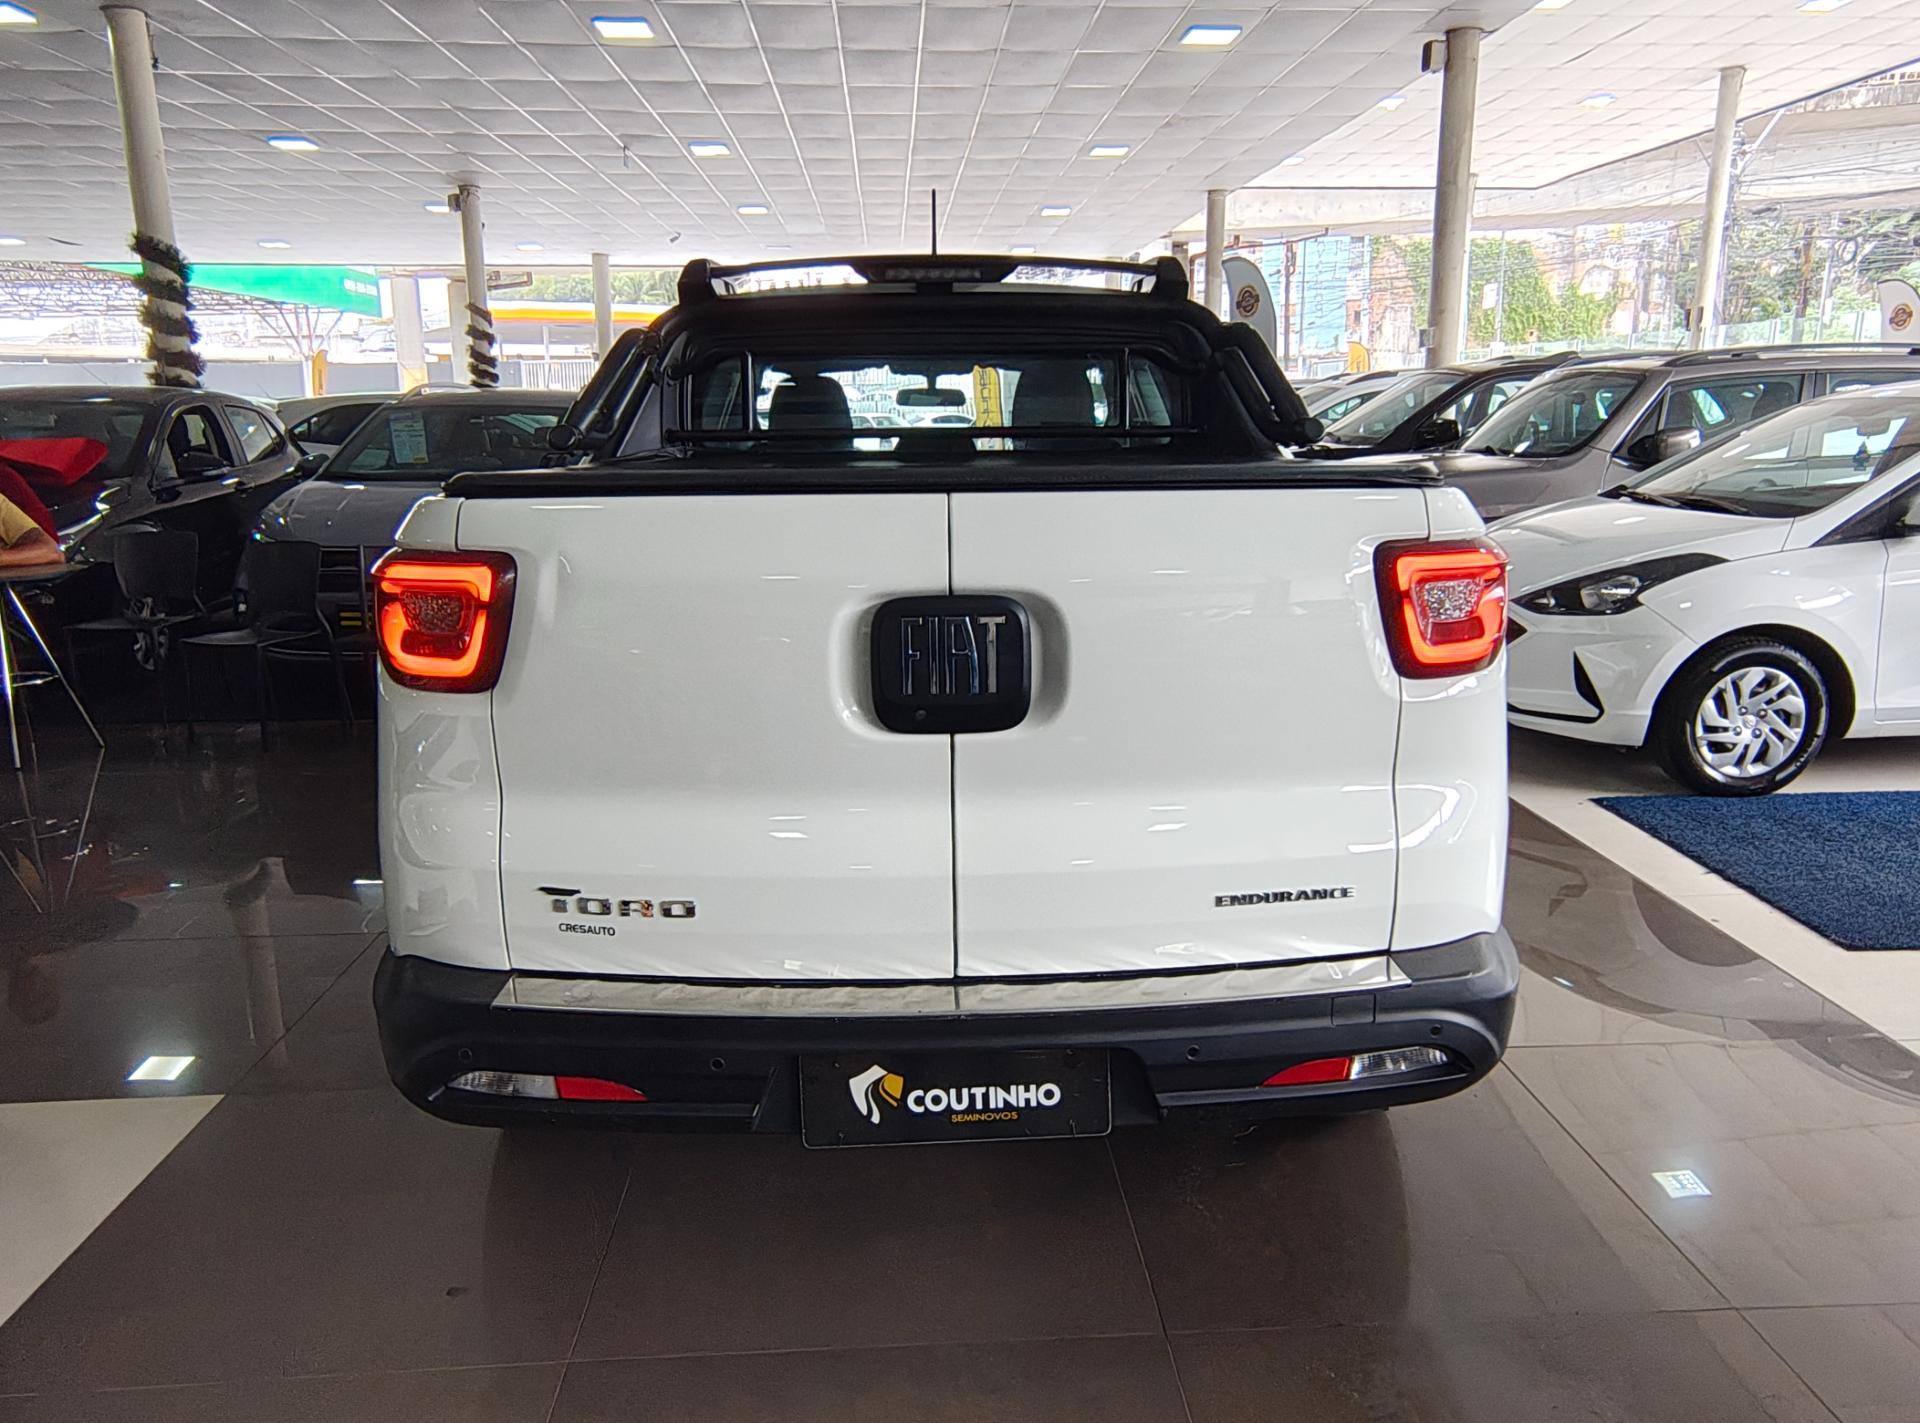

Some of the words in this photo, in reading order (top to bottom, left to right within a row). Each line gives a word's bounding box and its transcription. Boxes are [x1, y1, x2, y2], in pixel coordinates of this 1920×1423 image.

[901, 616, 1006, 695] FIAT
[535, 886, 697, 918] TORO
[1214, 887, 1355, 907] ENDURANCE
[558, 922, 616, 936] CRESAUTO
[906, 1083, 1061, 1113] COUTINHO
[951, 1112, 1019, 1123] SEMINOVOS
